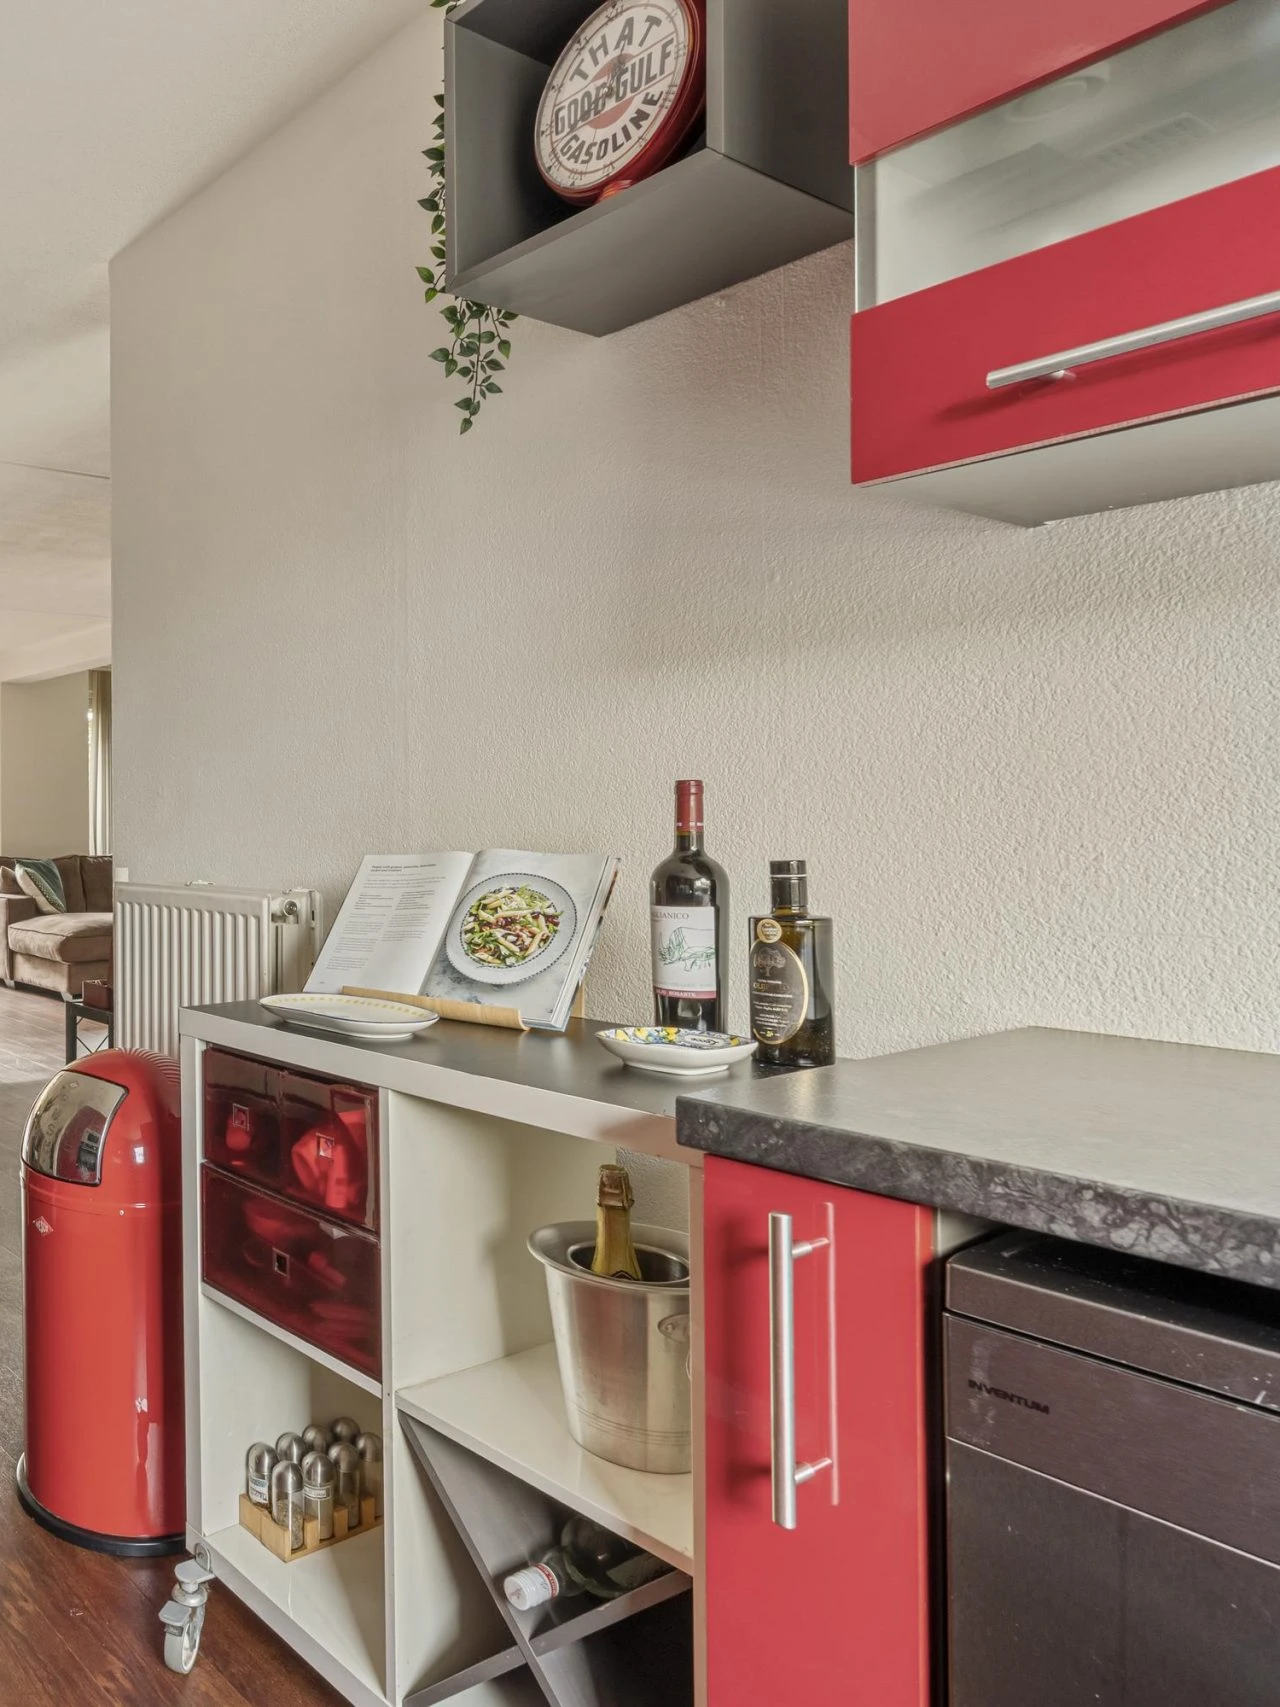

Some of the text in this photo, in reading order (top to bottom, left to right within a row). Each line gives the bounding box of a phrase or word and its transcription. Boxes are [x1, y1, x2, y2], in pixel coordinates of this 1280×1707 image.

[569, 15, 663, 82] THAT
[555, 37, 675, 136] GOOD GULF
[560, 90, 664, 164] GASOLINE
[968, 1378, 1050, 1416] INVENTUM
